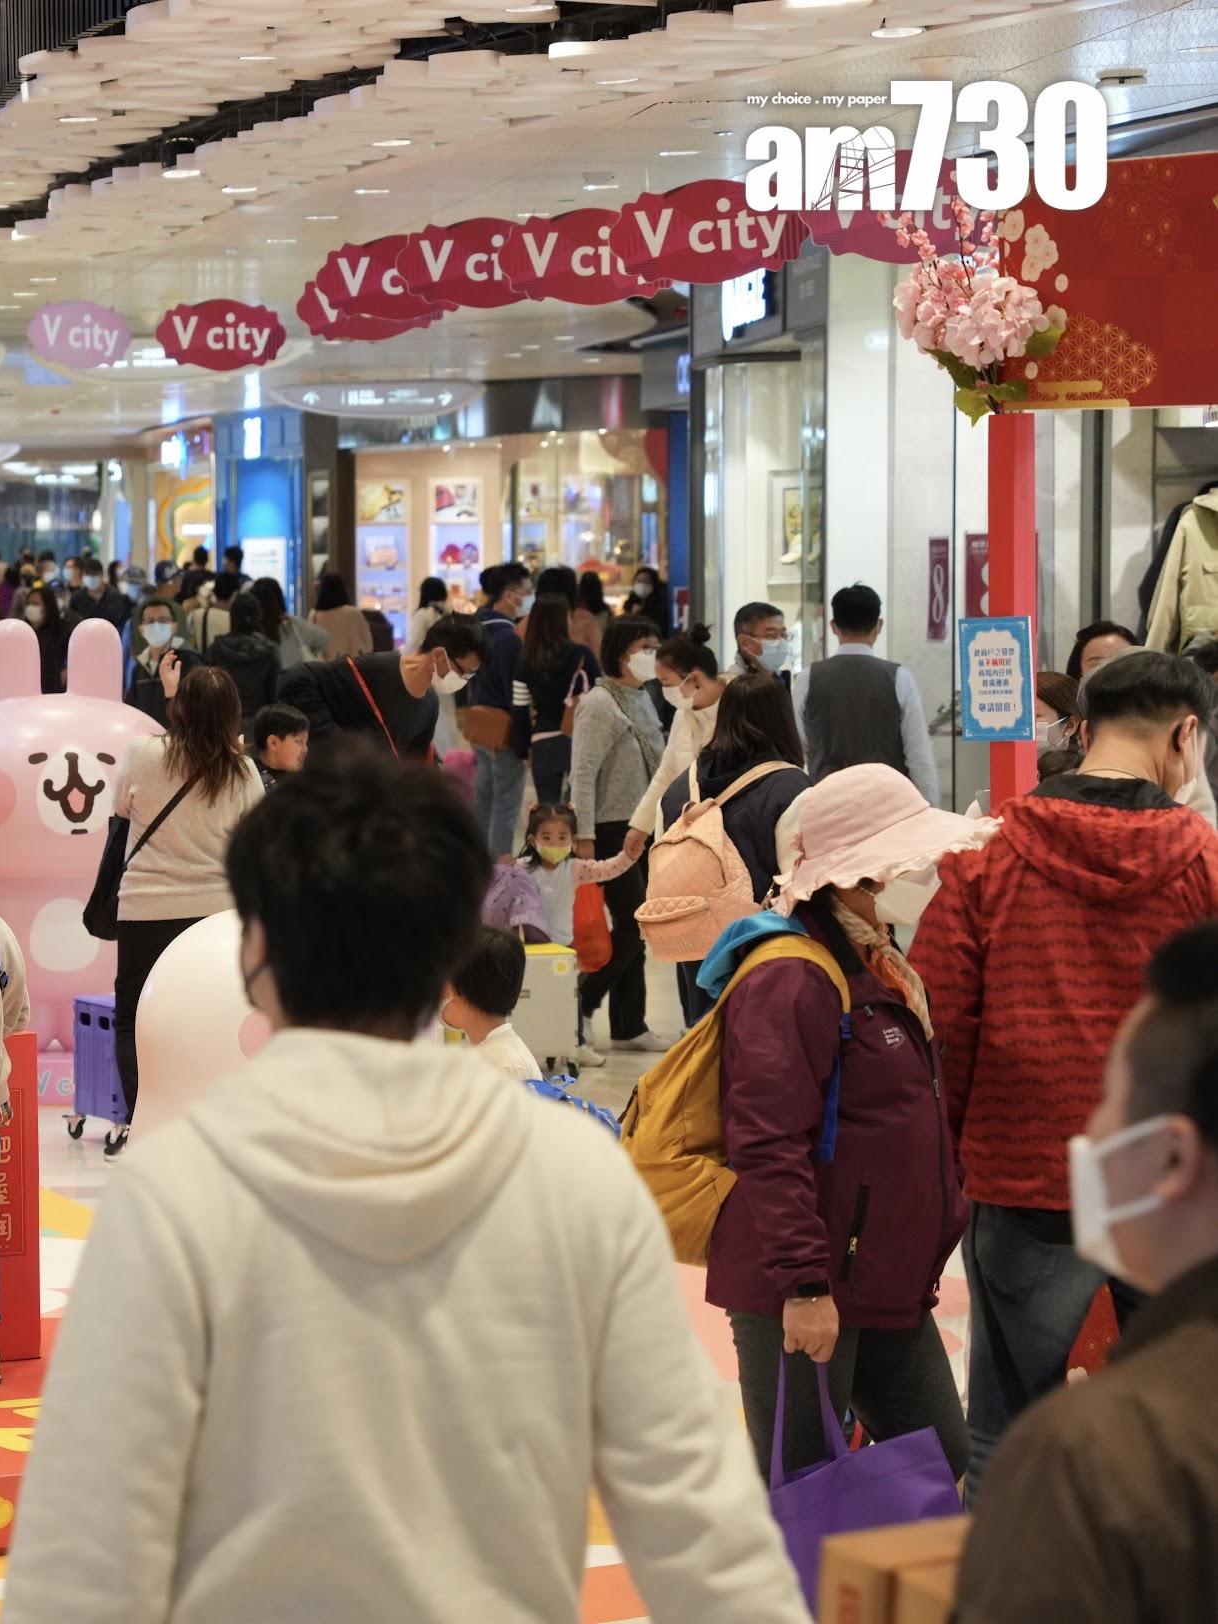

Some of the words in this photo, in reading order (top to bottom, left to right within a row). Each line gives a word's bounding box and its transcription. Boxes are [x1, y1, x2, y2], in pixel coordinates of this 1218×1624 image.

[634, 206, 673, 257] V
[688, 197, 788, 257] city
[337, 256, 370, 297] V
[419, 239, 454, 282] V
[465, 234, 504, 281] ci
[521, 232, 558, 277] V
[42, 314, 62, 346] V
[68, 314, 119, 357] city
[172, 315, 198, 350] V
[206, 312, 271, 357] city
